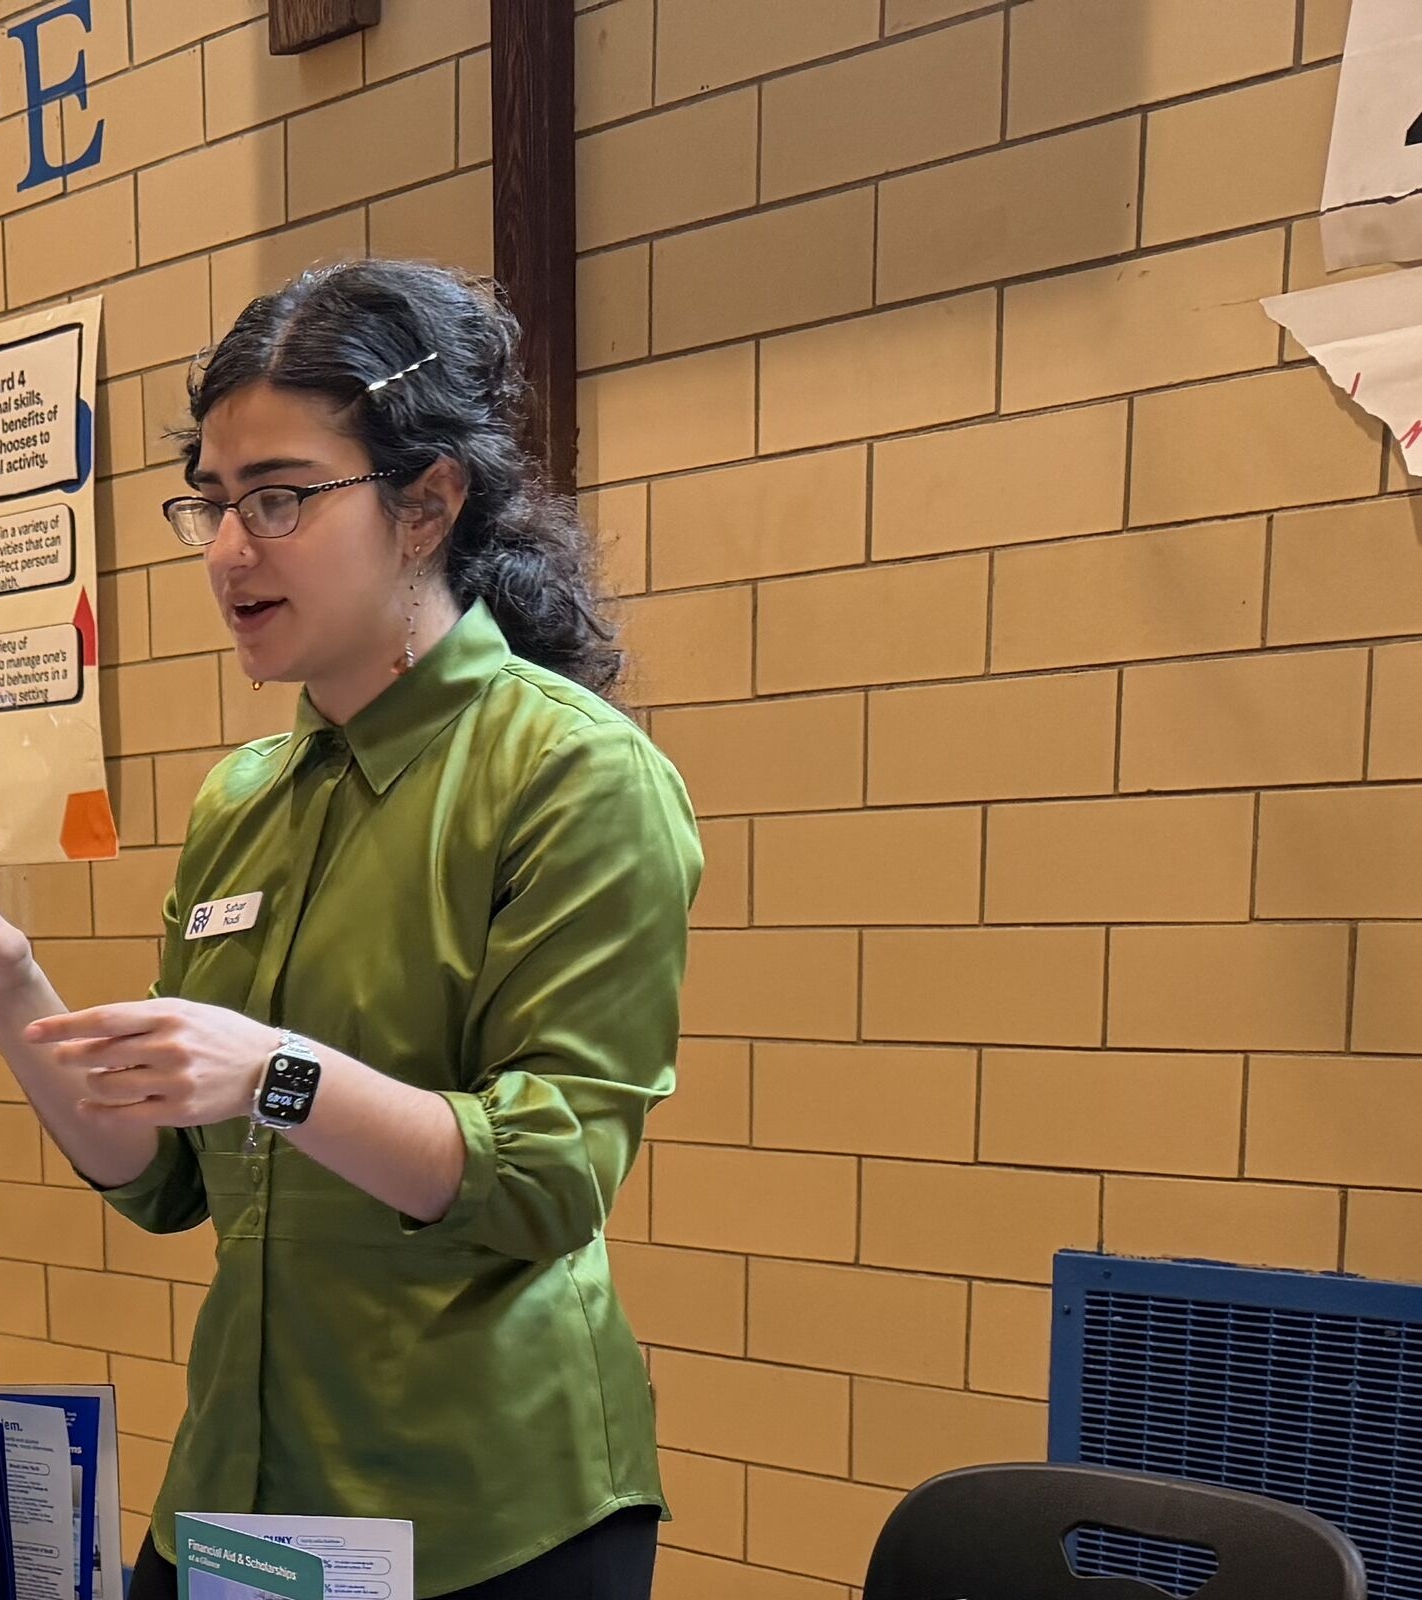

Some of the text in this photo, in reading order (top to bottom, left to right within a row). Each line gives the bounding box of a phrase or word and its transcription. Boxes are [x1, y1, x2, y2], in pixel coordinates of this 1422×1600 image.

[7, 0, 105, 193] E
[17, 370, 26, 387] 4
[14, 390, 43, 410] skills,
[2, 409, 45, 432] benefits
[47, 405, 58, 421] of
[39, 430, 50, 444] to
[6, 452, 48, 473] activity.
[0, 526, 9, 539] in
[11, 526, 17, 538] a
[18, 518, 48, 536] variety
[50, 515, 60, 529] of
[25, 539, 43, 552] that
[45, 535, 61, 547] can
[21, 552, 59, 571] personal
[18, 636, 27, 650] of
[7, 653, 41, 670] manage
[43, 650, 66, 664] one's
[7, 668, 49, 685] behaviors
[51, 667, 60, 679] in
[62, 669, 68, 679] a
[19, 688, 48, 704] setting
[188, 1538, 296, 1581] Financial Aid & Scholarships
